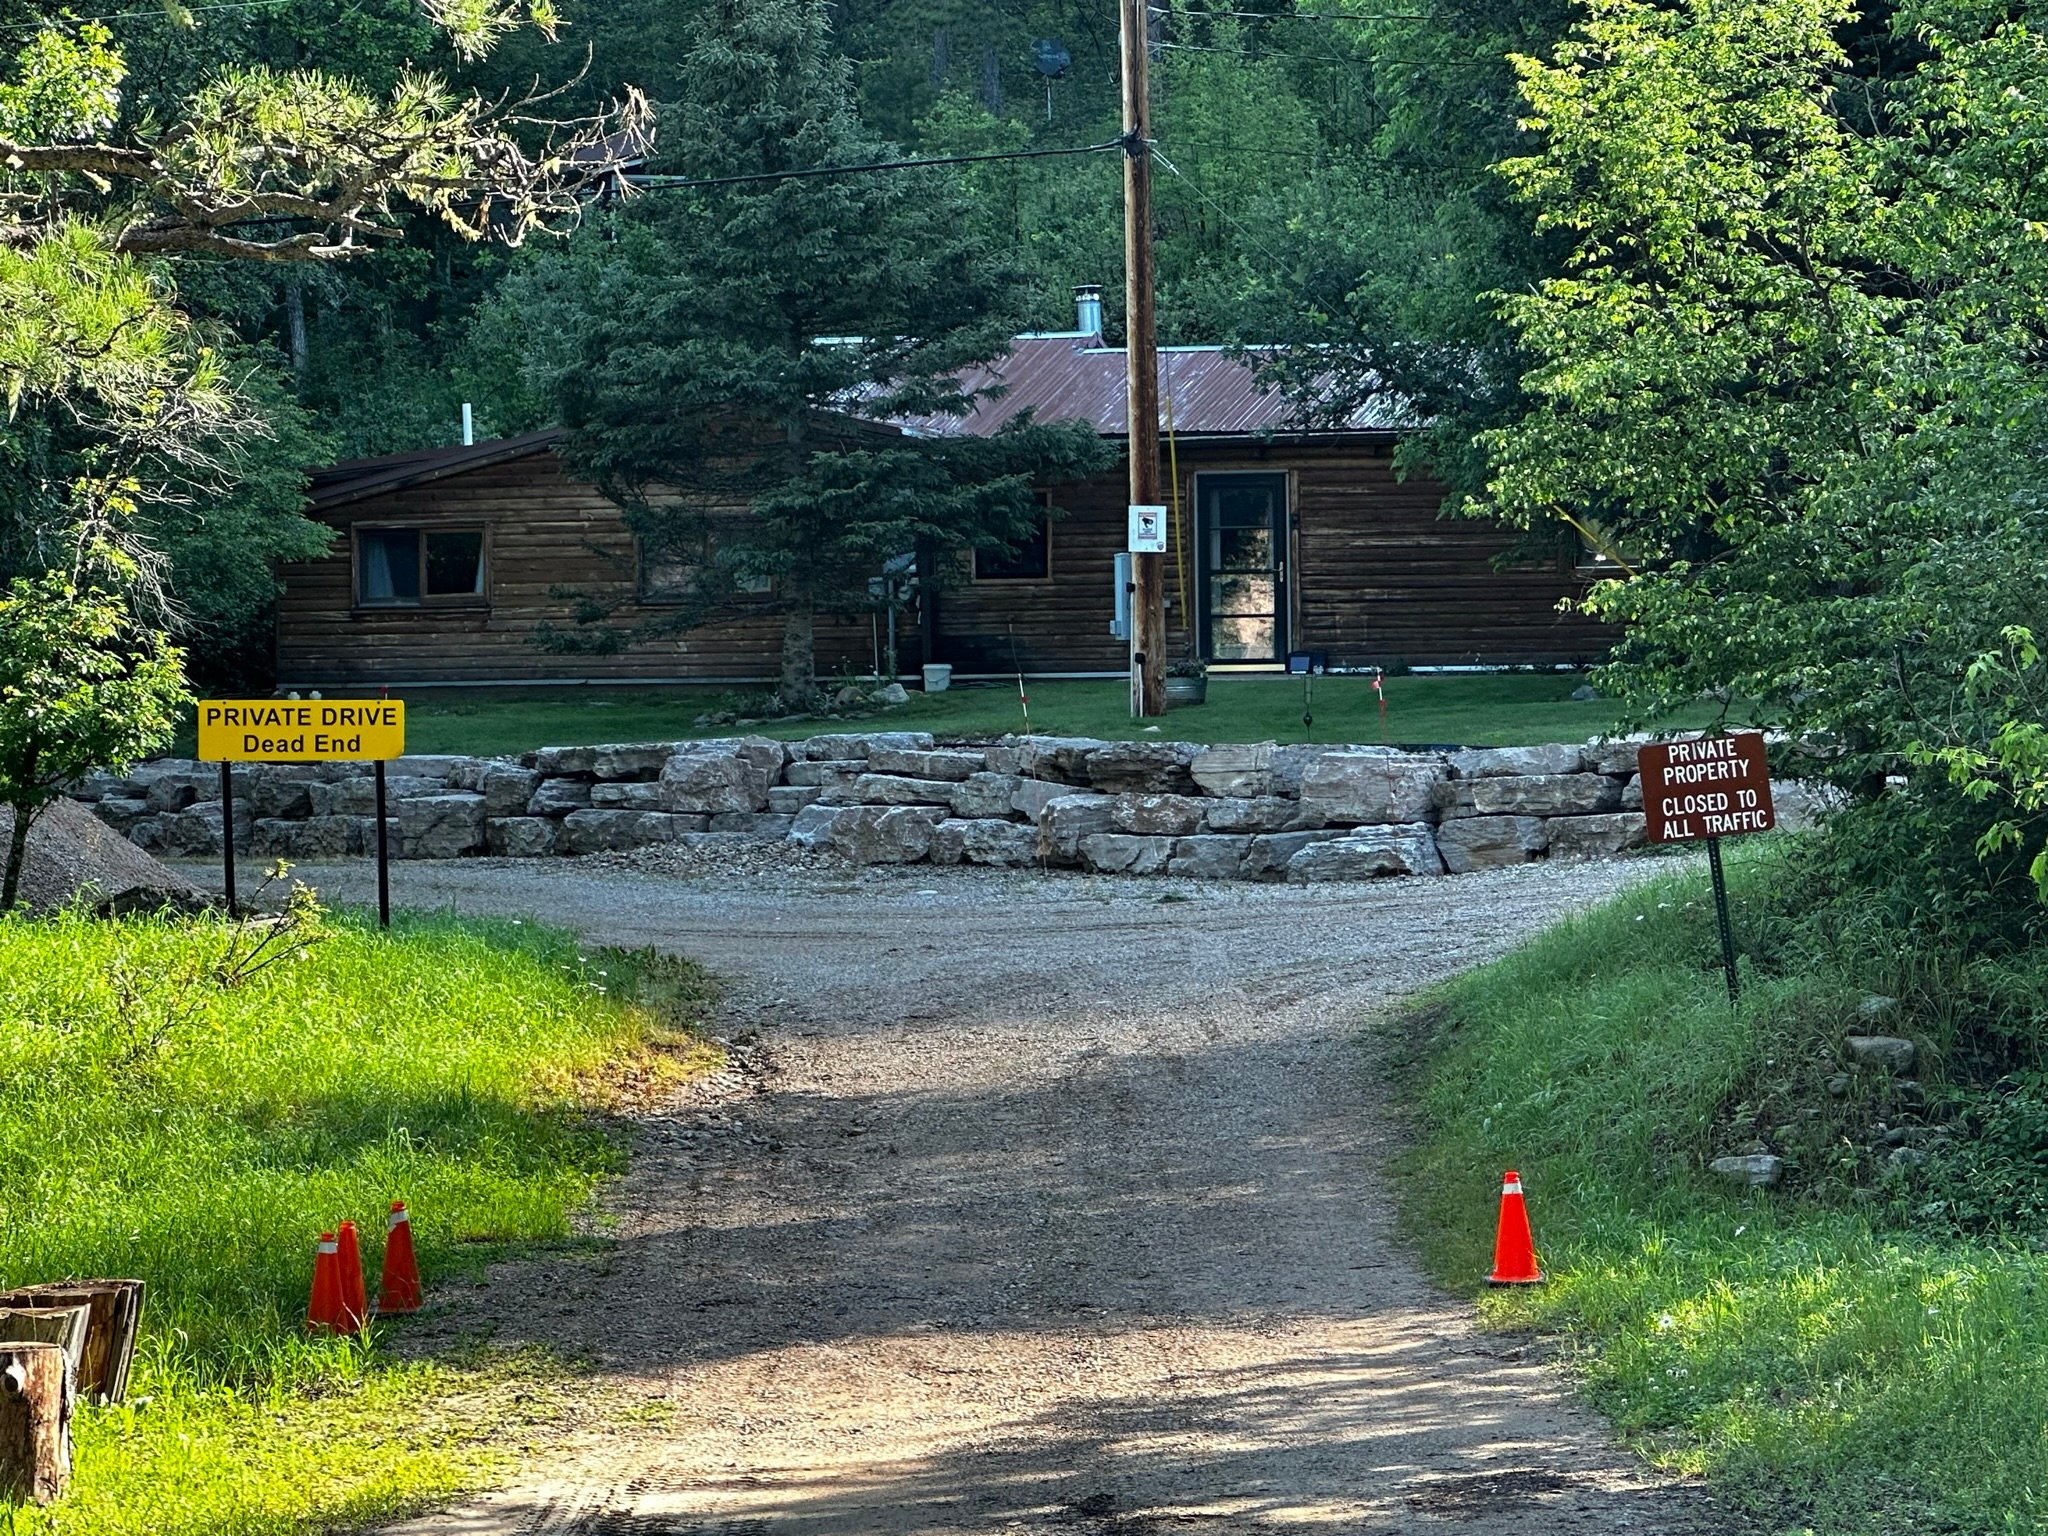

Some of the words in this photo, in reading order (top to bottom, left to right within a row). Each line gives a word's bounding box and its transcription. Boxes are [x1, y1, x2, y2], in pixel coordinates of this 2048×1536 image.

[207, 708, 312, 726] PRIVATE
[322, 708, 397, 726] DRIVE
[244, 735, 304, 753] Dead
[315, 735, 361, 752] End
[1668, 738, 1738, 764] PRIVATE
[1663, 758, 1750, 786] PROPERTY
[1662, 793, 1728, 817] CLOSED
[1736, 789, 1757, 808] TO
[1663, 819, 1695, 839] ALL
[1702, 809, 1768, 834] TRAFFIC
